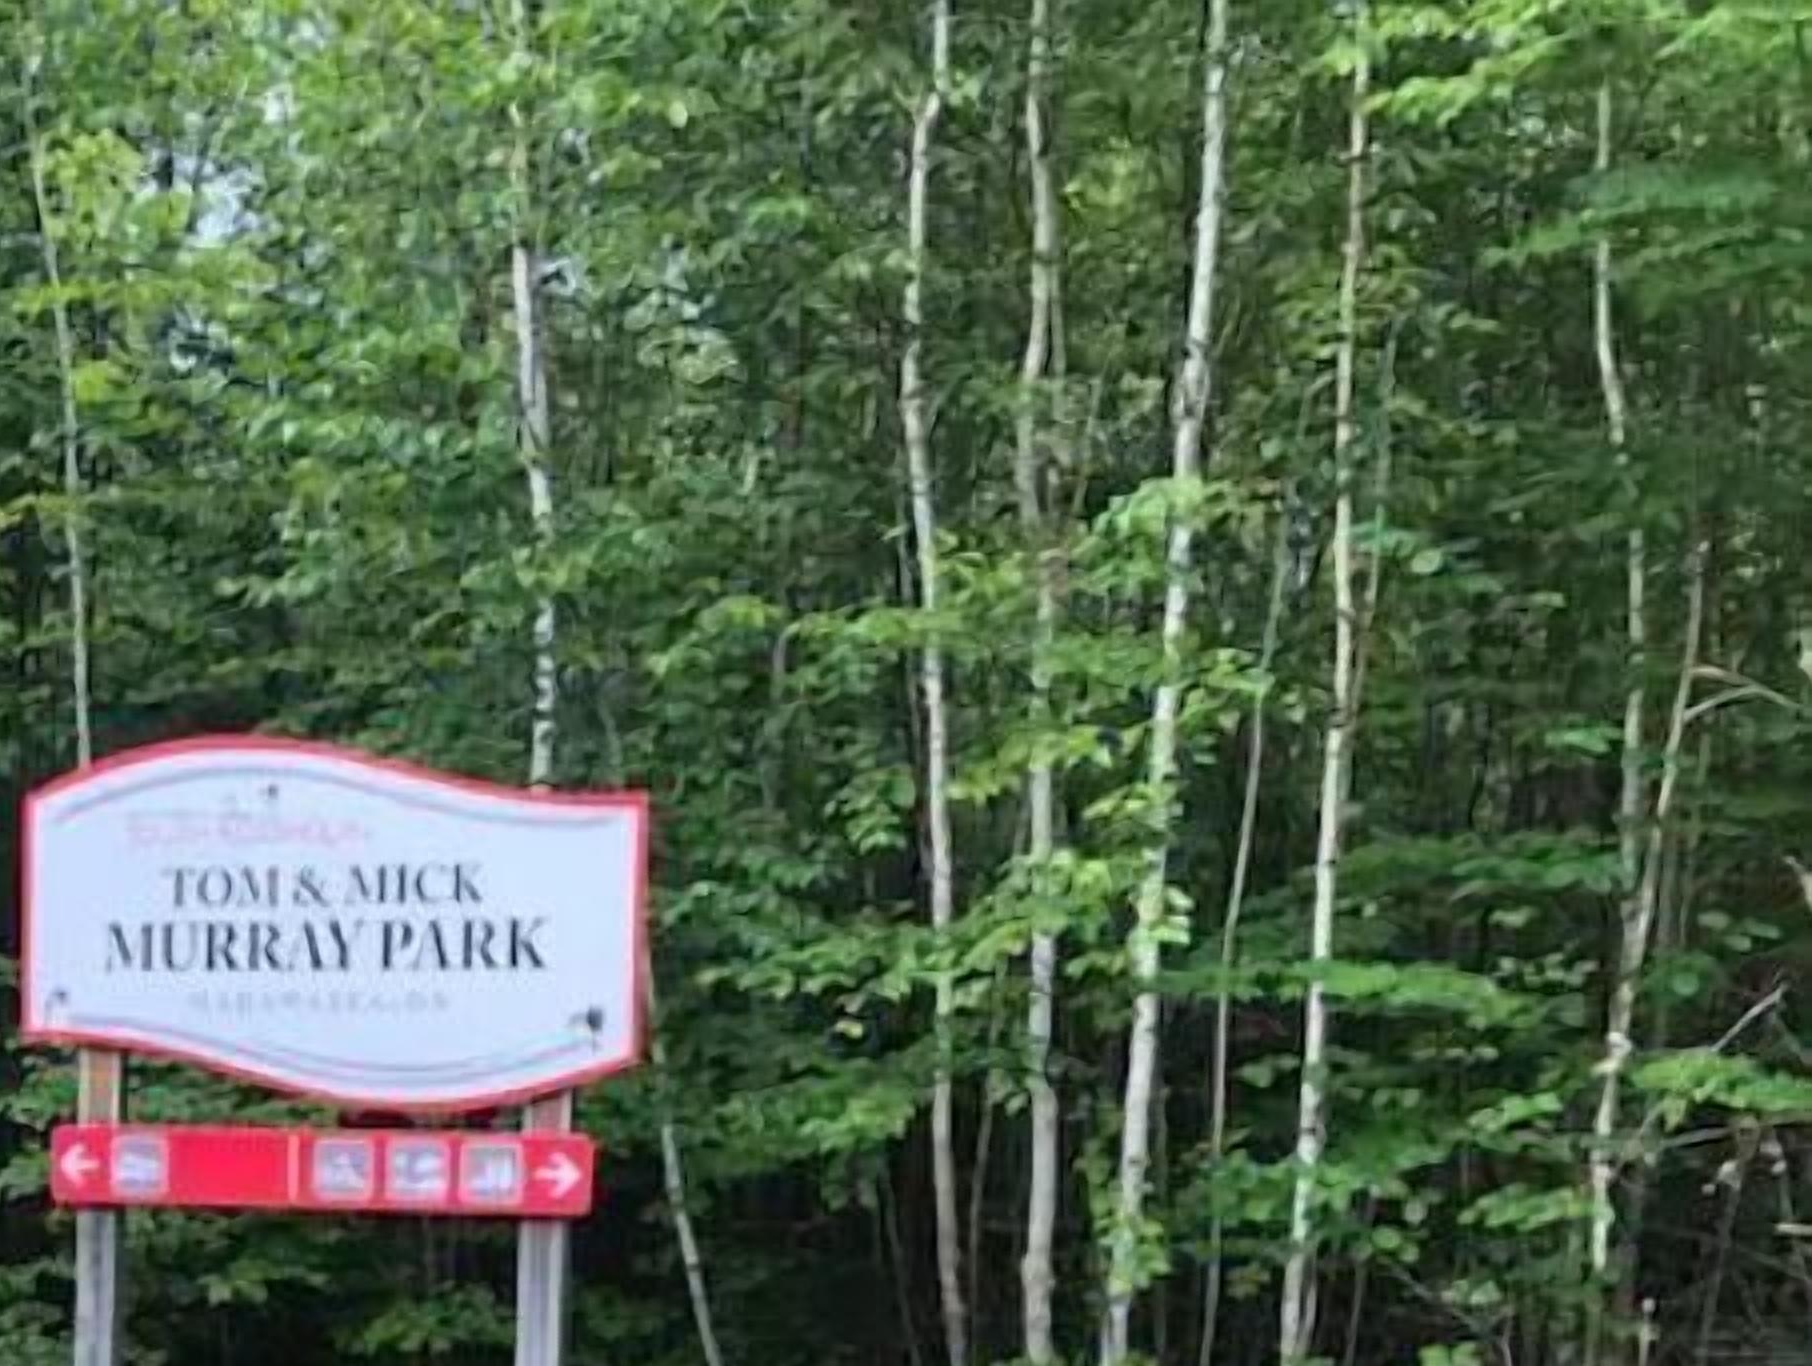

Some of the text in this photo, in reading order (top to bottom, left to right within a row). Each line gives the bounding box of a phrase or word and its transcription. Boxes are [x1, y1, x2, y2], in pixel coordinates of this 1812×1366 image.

[163, 863, 483, 907] TOM & MICK
[105, 918, 546, 972] MURRAY PARK
